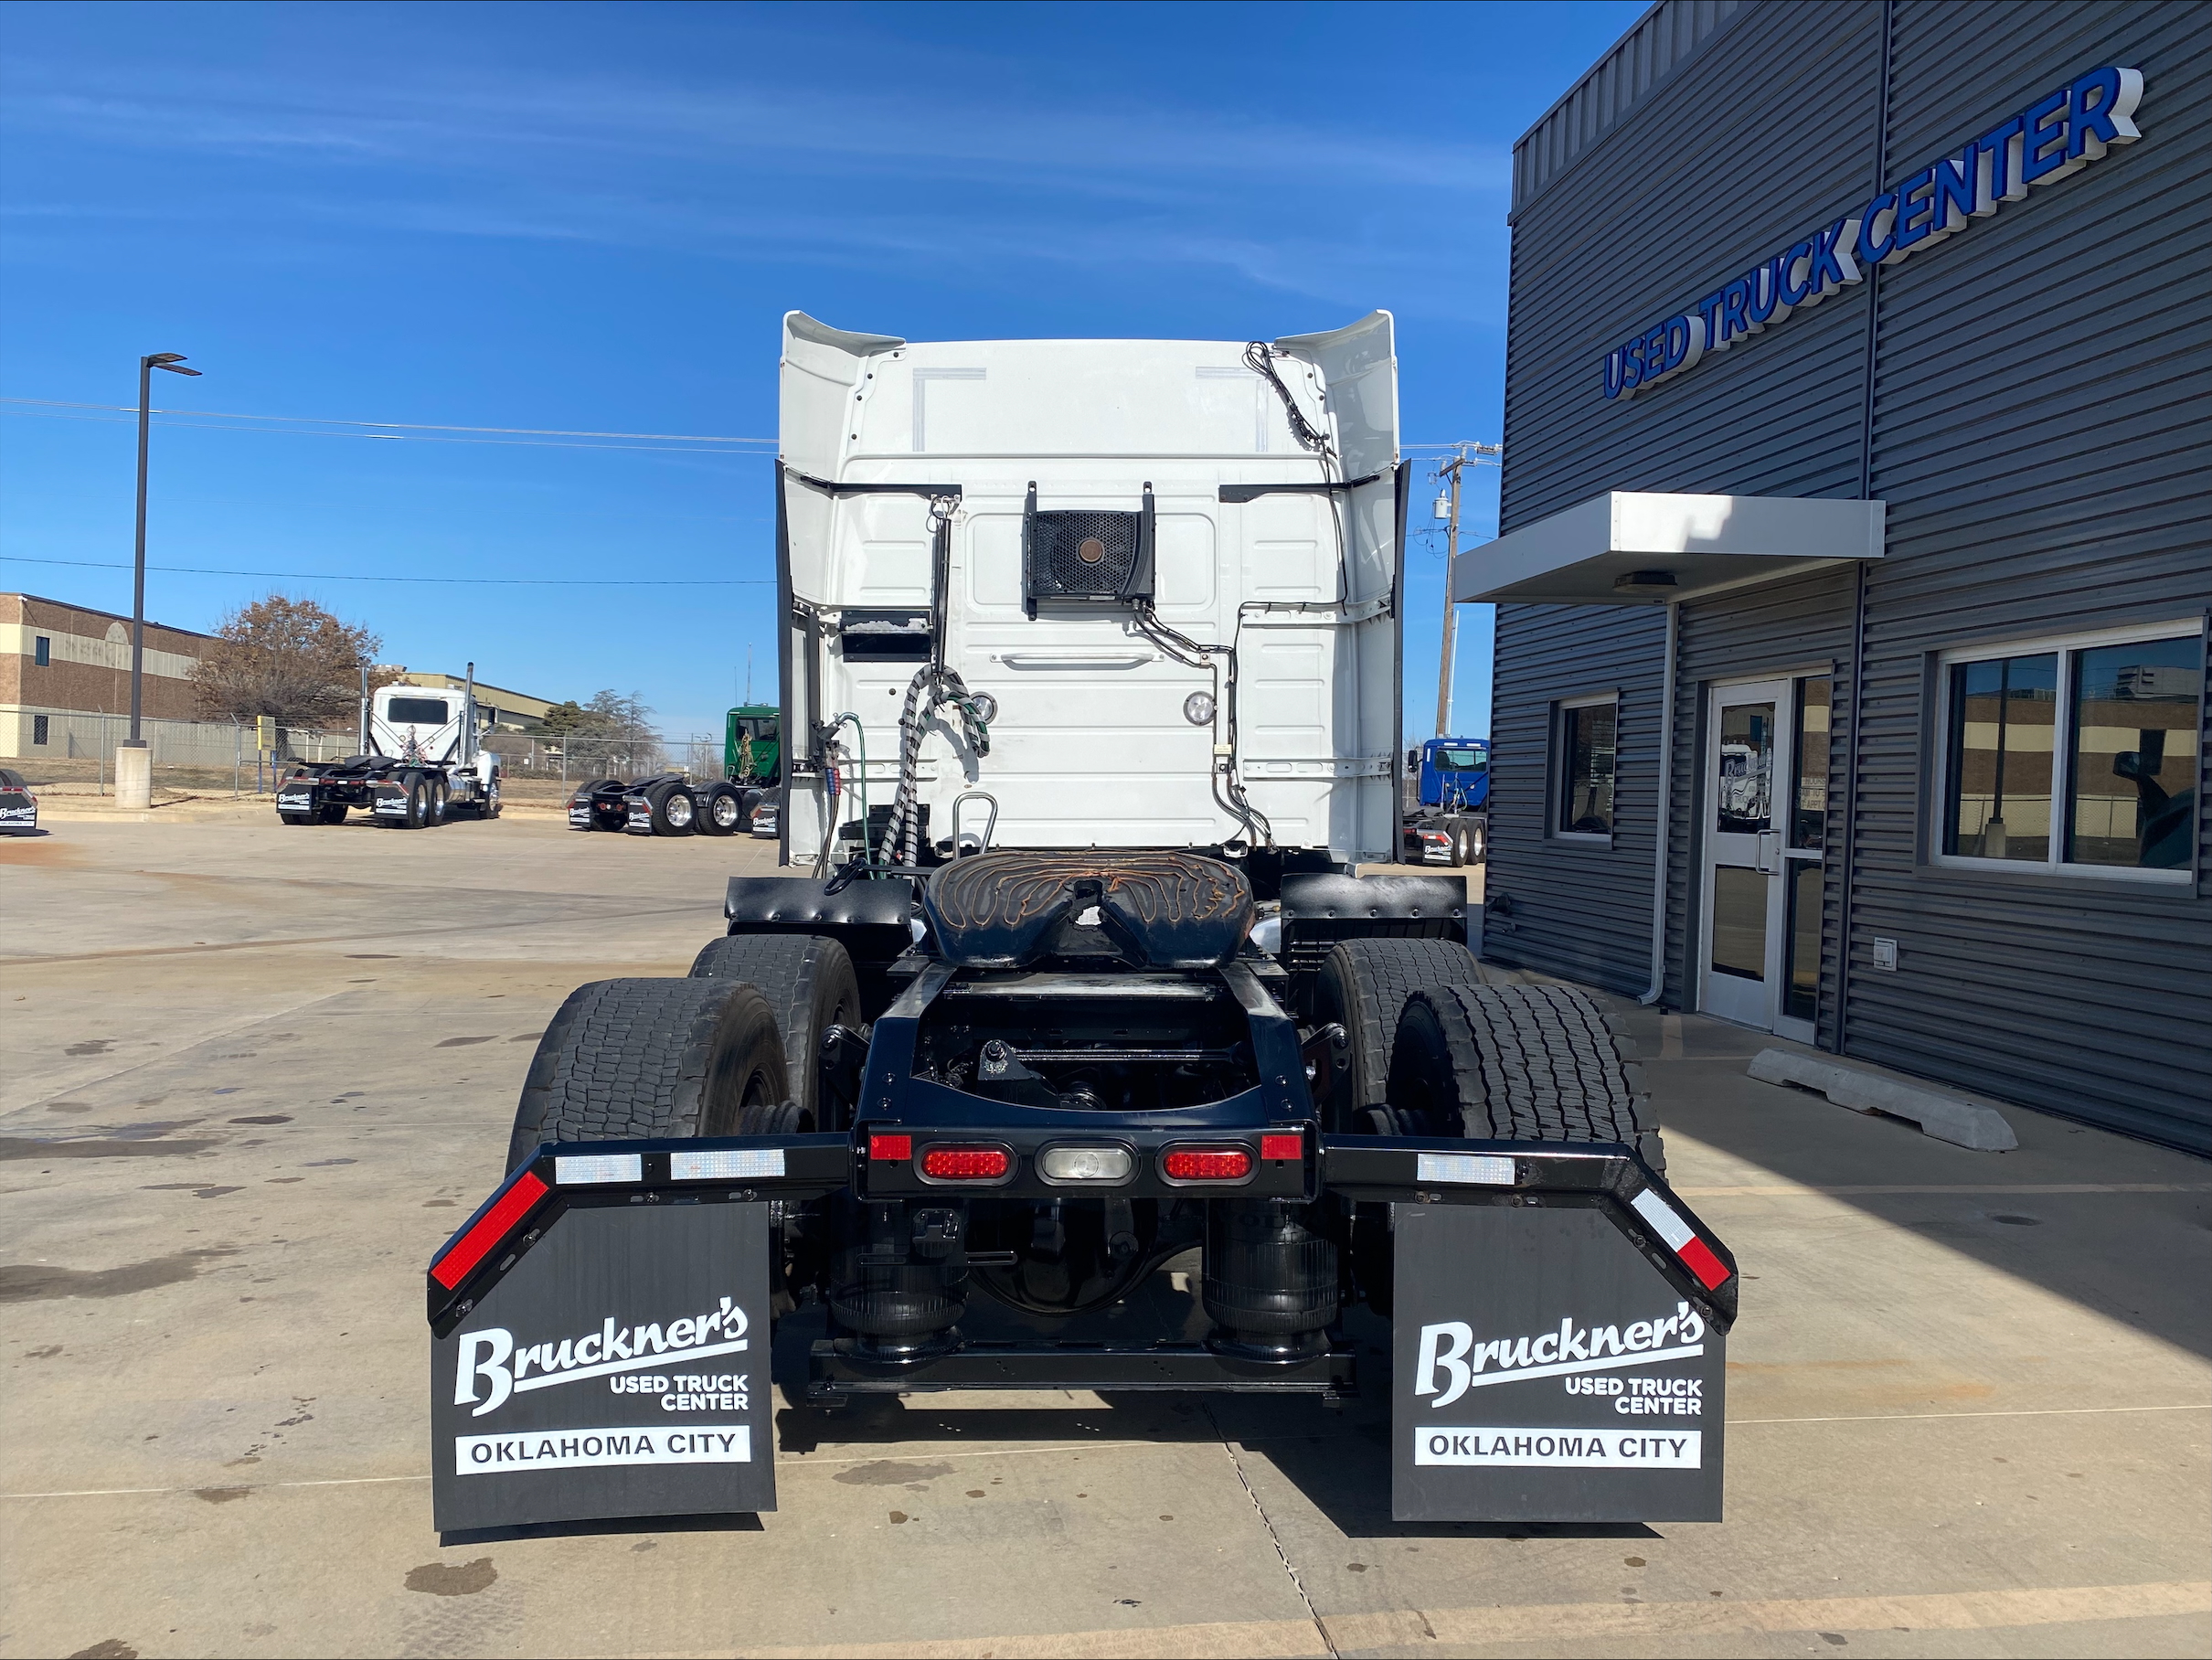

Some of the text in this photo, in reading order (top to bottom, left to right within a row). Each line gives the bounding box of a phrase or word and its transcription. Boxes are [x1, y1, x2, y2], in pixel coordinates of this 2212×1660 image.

[1604, 67, 2137, 399] USED TRUCK CENTER
[454, 1296, 749, 1417] Bruckner's
[1414, 1301, 1706, 1408] Bruckner's
[610, 1374, 748, 1393] USED TRUCK
[1565, 1377, 1703, 1397] USED TRUCK
[660, 1393, 749, 1411] CENTER
[1614, 1397, 1702, 1416] CENTER
[471, 1432, 737, 1464] OKLAHOMA CITY
[1429, 1434, 1688, 1459] OKLAHOMA CITY
